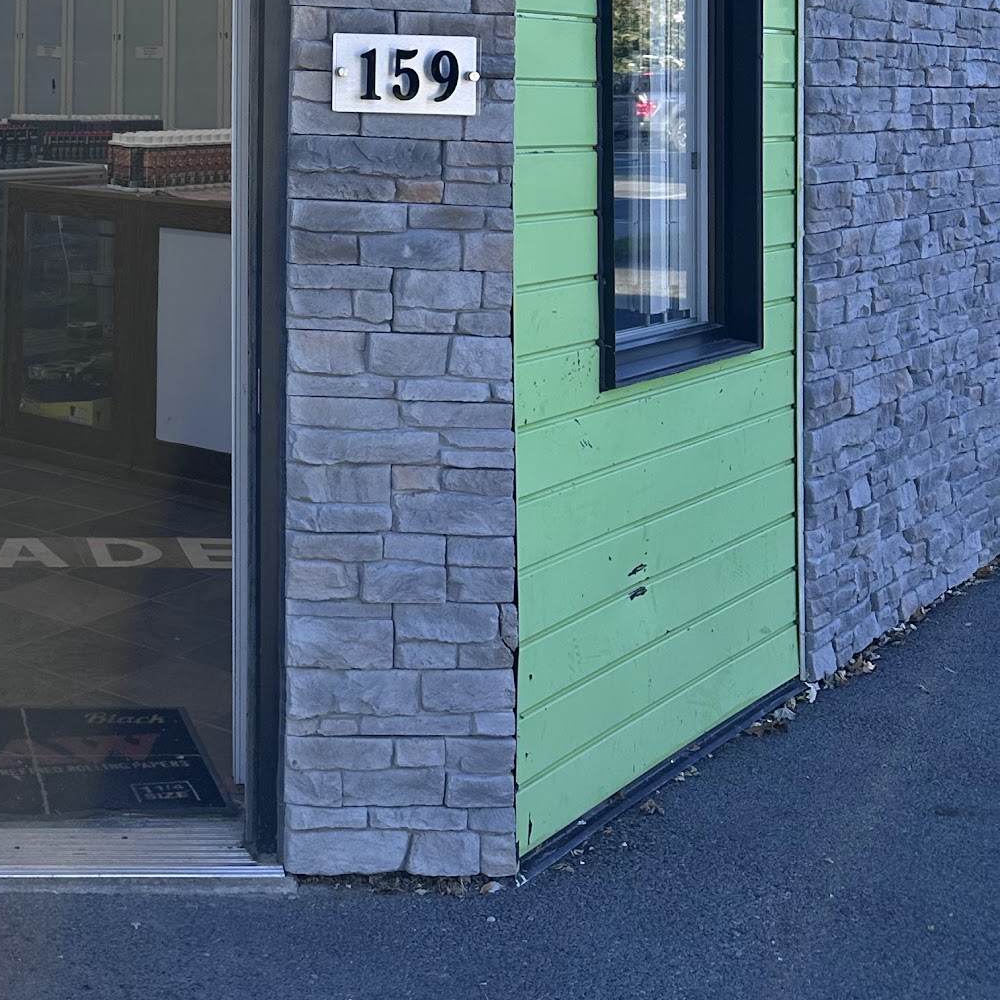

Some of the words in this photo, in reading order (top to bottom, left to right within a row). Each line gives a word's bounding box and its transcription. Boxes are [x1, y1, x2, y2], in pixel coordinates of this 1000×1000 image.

[360, 48, 459, 102] 159
[84, 712, 167, 725] Black
[133, 759, 190, 770] PAPERS
